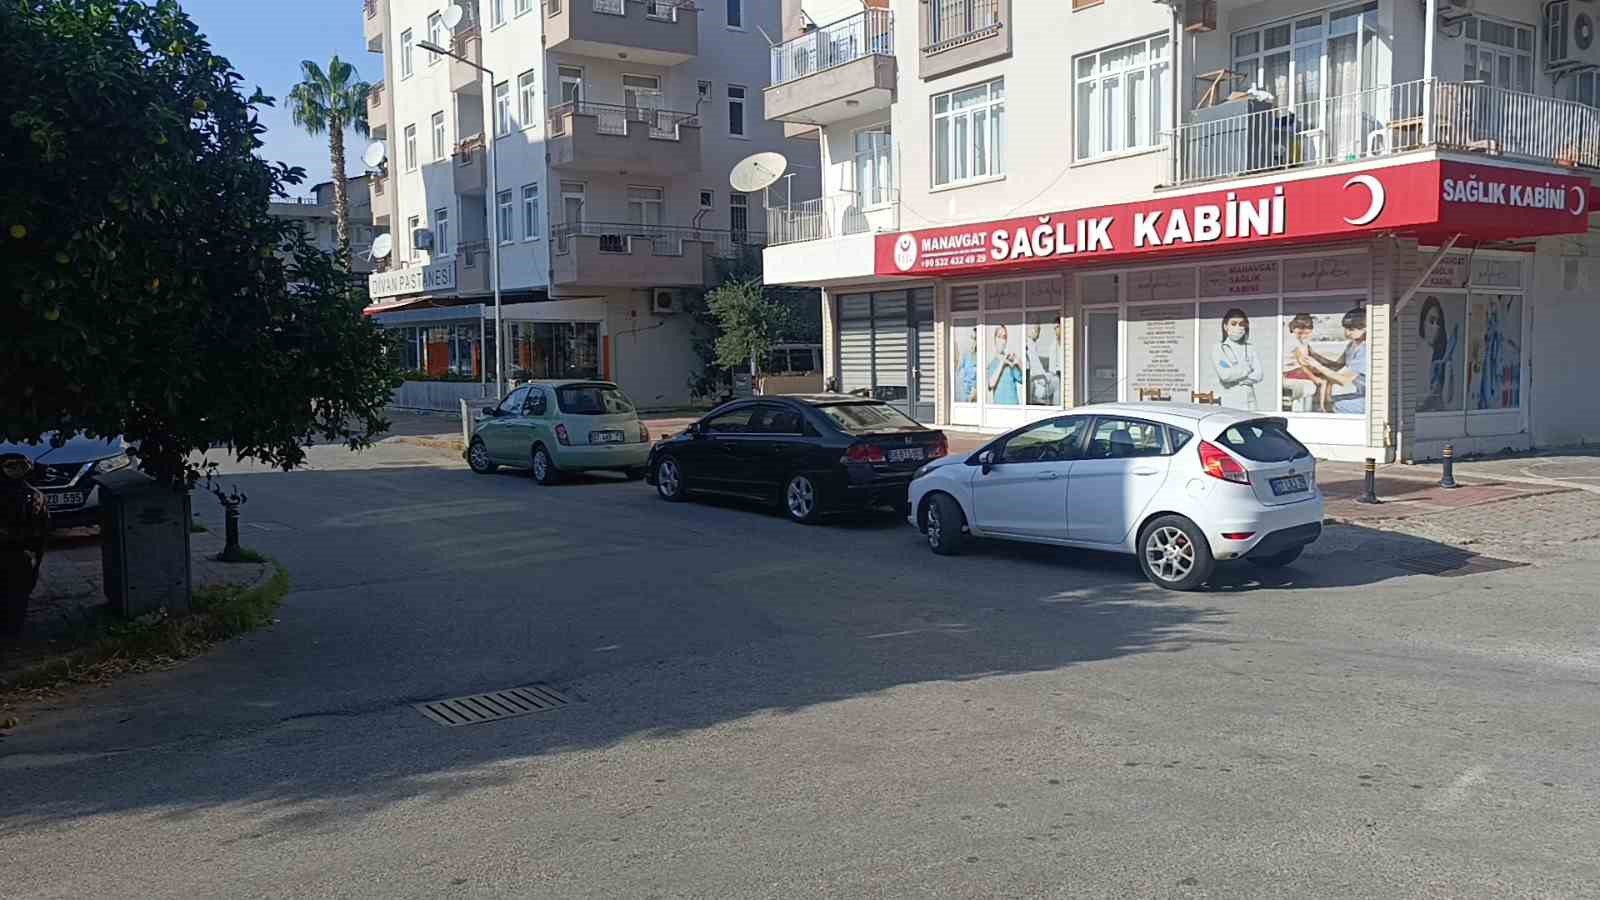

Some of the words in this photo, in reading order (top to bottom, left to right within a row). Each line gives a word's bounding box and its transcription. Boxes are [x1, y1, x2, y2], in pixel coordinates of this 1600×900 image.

[1443, 174, 1506, 205] SAĞLIK
[1509, 182, 1566, 209] KABİNİ
[991, 216, 1113, 260] SAĞLIK
[1133, 186, 1286, 248] KABİNİ
[921, 232, 987, 251] MANAVGAT
